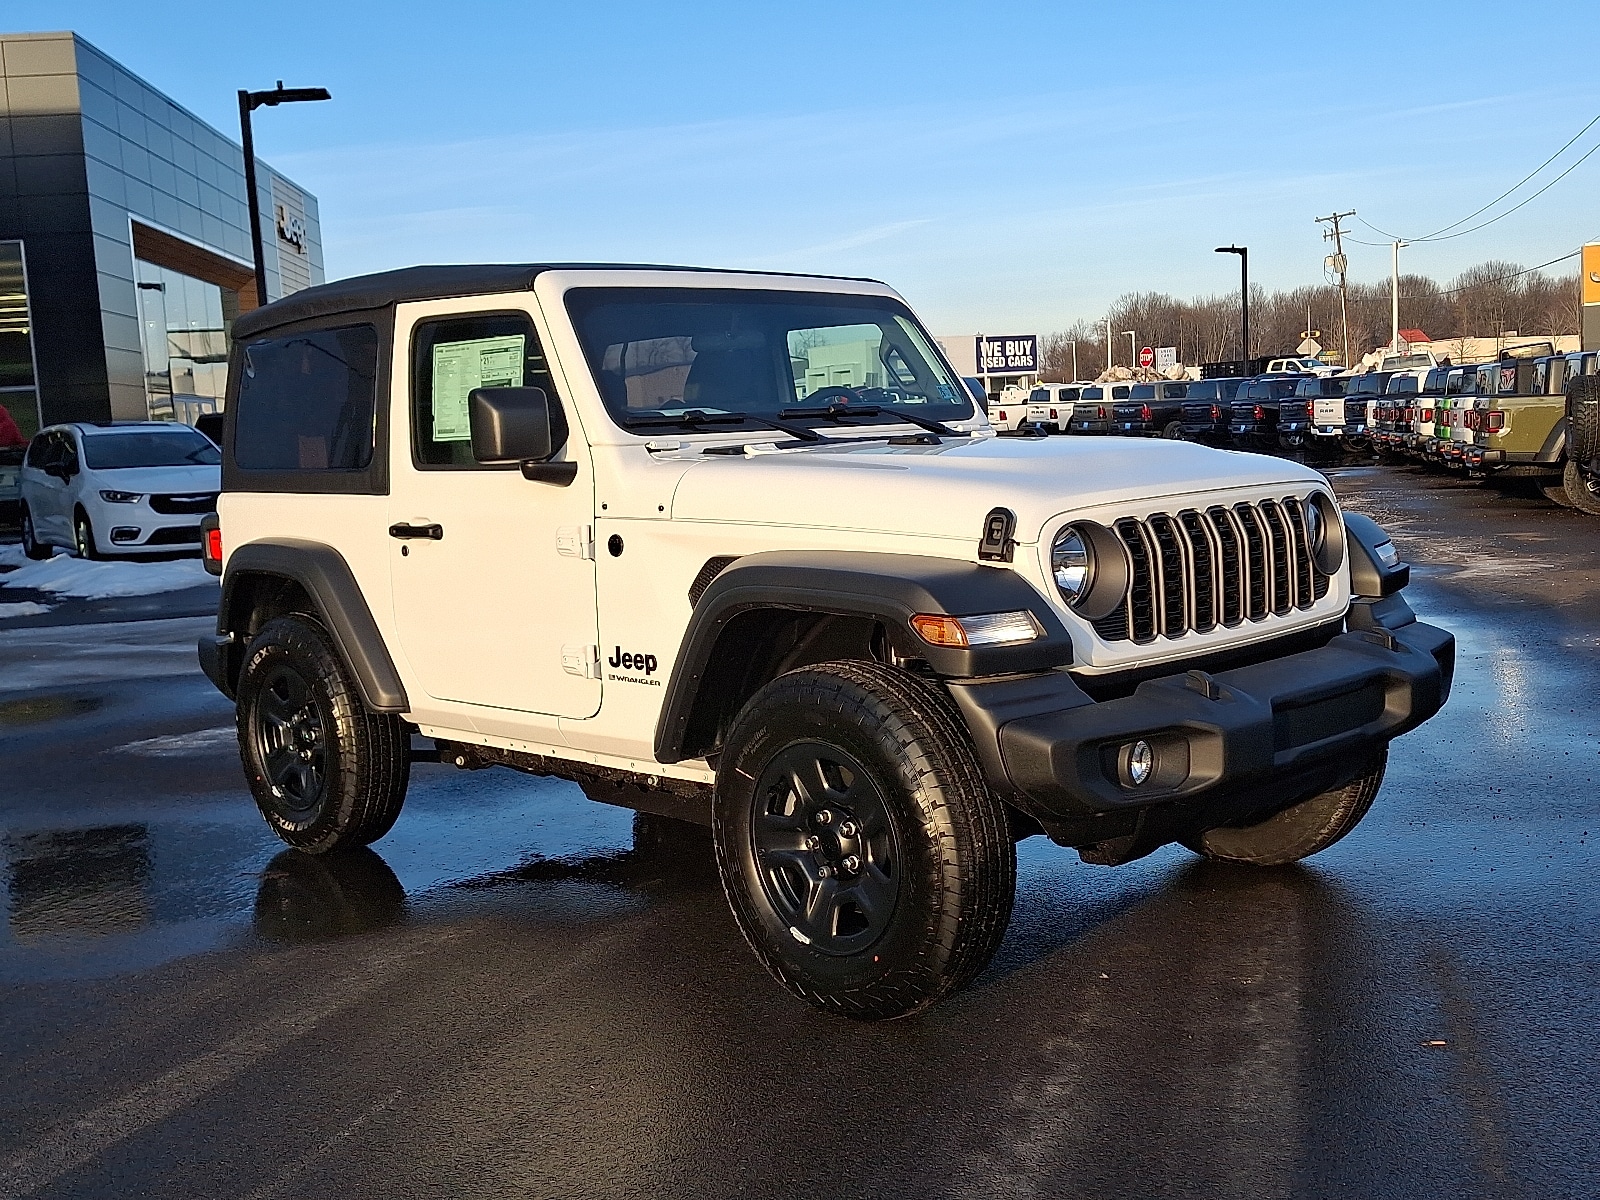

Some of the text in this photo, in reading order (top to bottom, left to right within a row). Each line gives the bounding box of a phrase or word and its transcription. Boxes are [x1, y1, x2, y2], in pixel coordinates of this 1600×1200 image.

[980, 340, 1033, 357] WE BUY
[980, 355, 1034, 368] USED CARS
[608, 645, 658, 676] Jeep
[616, 674, 661, 687] WRANGLER
